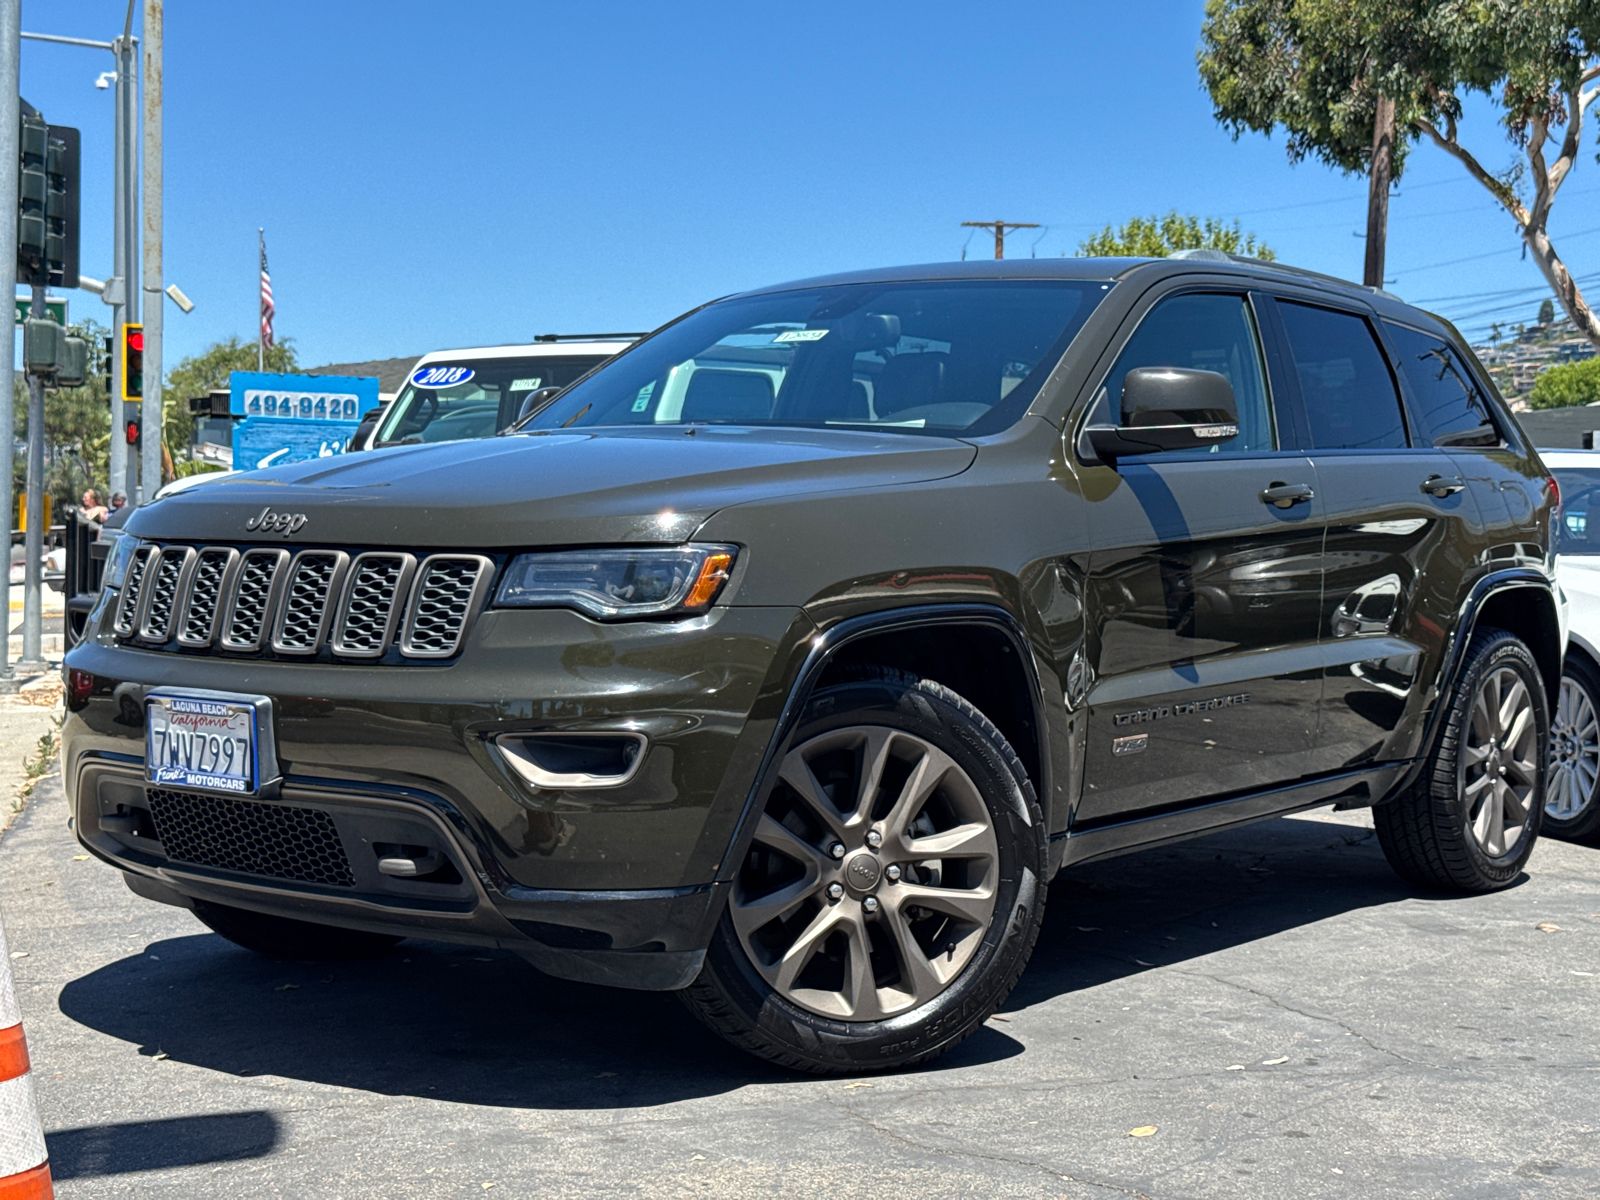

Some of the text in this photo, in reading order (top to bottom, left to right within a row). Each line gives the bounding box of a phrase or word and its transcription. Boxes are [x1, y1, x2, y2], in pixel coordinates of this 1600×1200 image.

[422, 366, 467, 384] 2018
[248, 395, 356, 416] 494-9420
[246, 506, 309, 538] Jeep
[171, 702, 227, 715] LAGUNA BEACH
[1114, 693, 1251, 727] GRAND CHEROKEE
[170, 714, 236, 731] California
[154, 730, 248, 777] 7WVZ997
[187, 775, 245, 790] MOTORCARS
